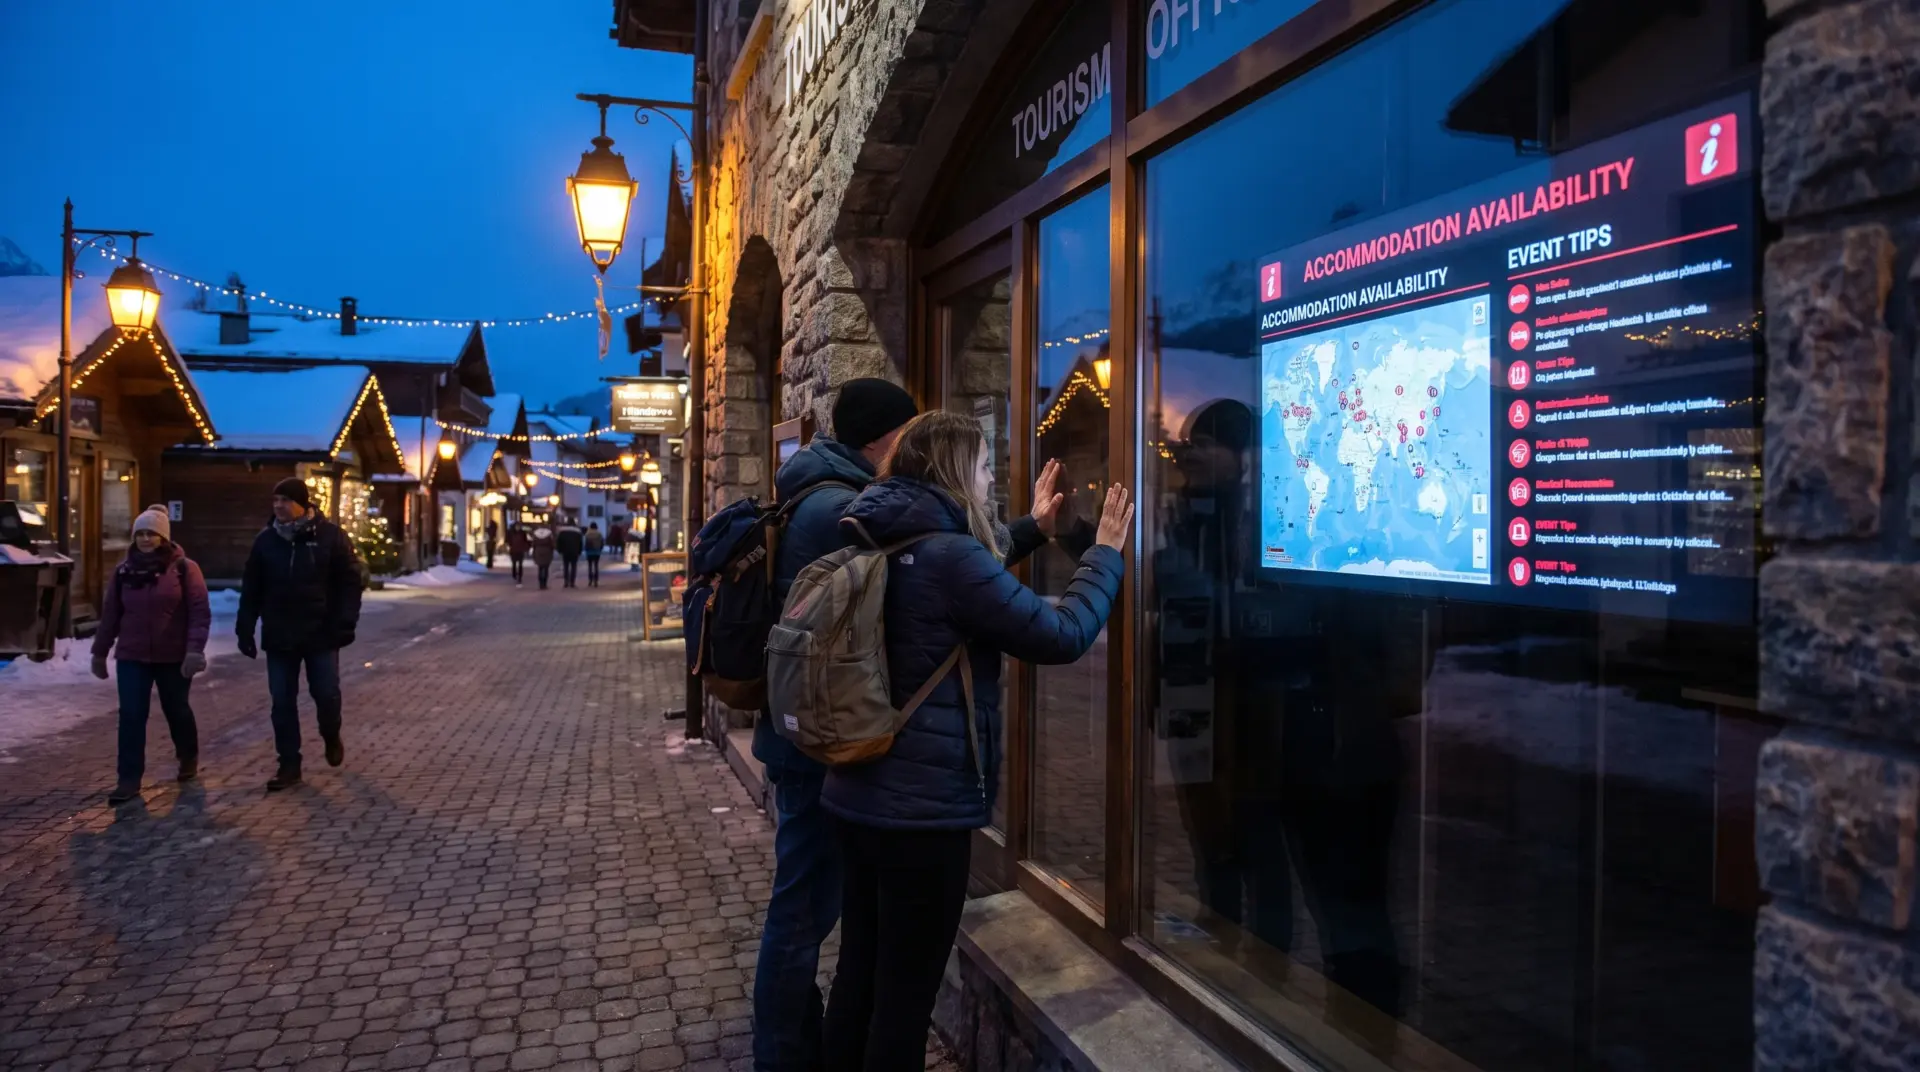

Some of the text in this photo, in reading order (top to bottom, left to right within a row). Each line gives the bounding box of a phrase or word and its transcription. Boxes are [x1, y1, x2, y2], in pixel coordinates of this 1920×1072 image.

[1012, 42, 1110, 158] TOURISM
[1304, 212, 1461, 283] ACCOMMODATION
[1466, 157, 1635, 235] AVAILABILITY
[1508, 224, 1612, 269] EVENT TIPS
[1261, 266, 1449, 330] ACCOMMODATION AVAILABILITY
